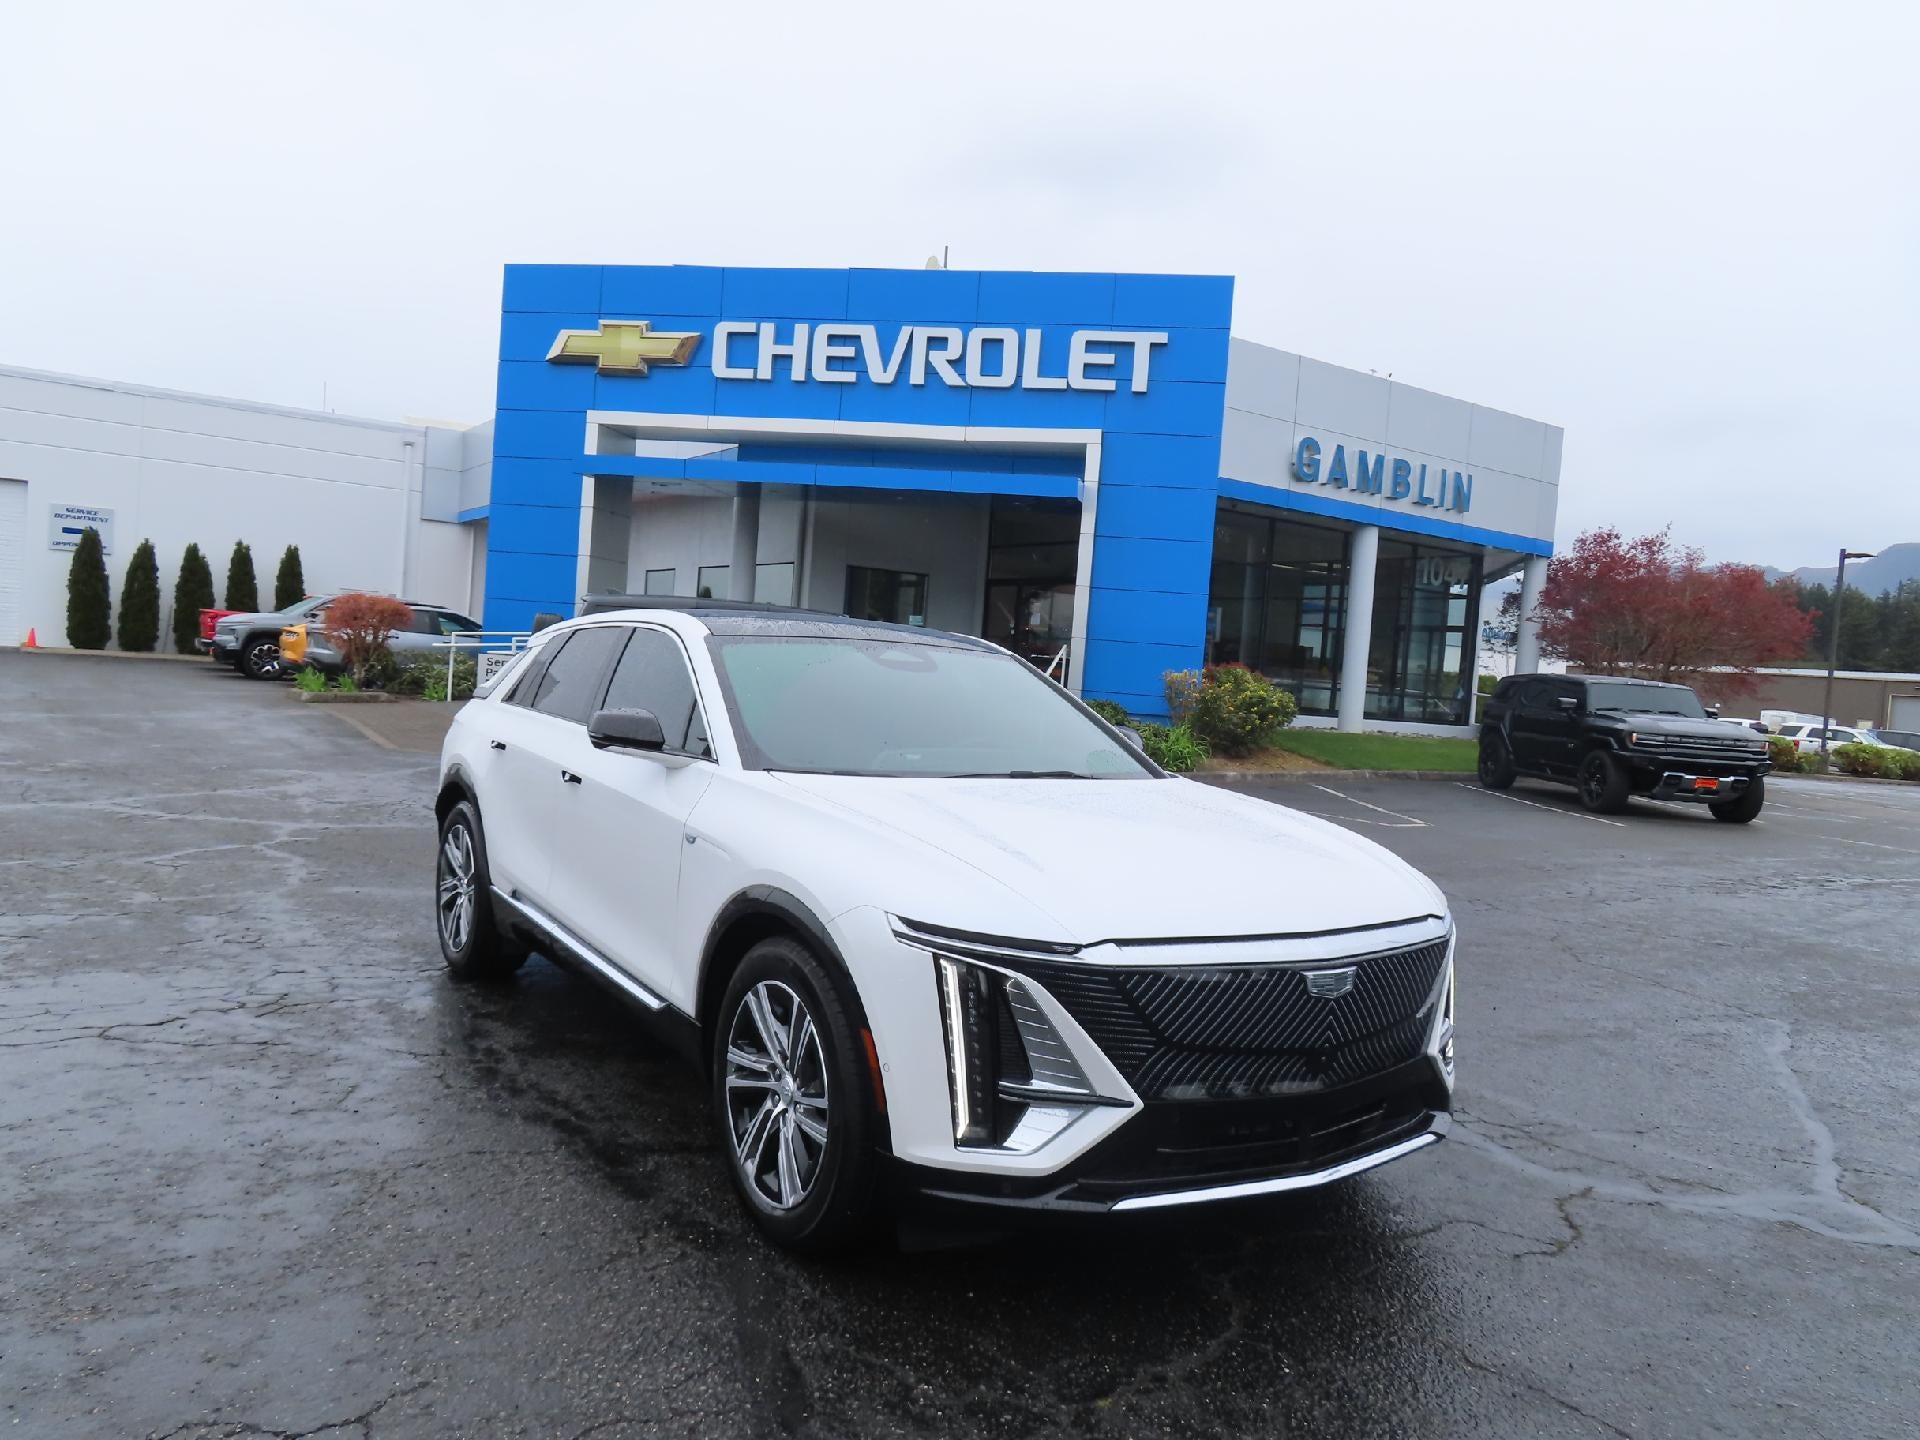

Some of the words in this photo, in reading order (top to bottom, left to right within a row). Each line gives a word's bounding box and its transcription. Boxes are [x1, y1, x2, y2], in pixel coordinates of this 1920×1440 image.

[711, 321, 1169, 393] CHEVROLET
[1294, 436, 1473, 514] GAMBLIN
[54, 512, 109, 523] DEPARTMENT
